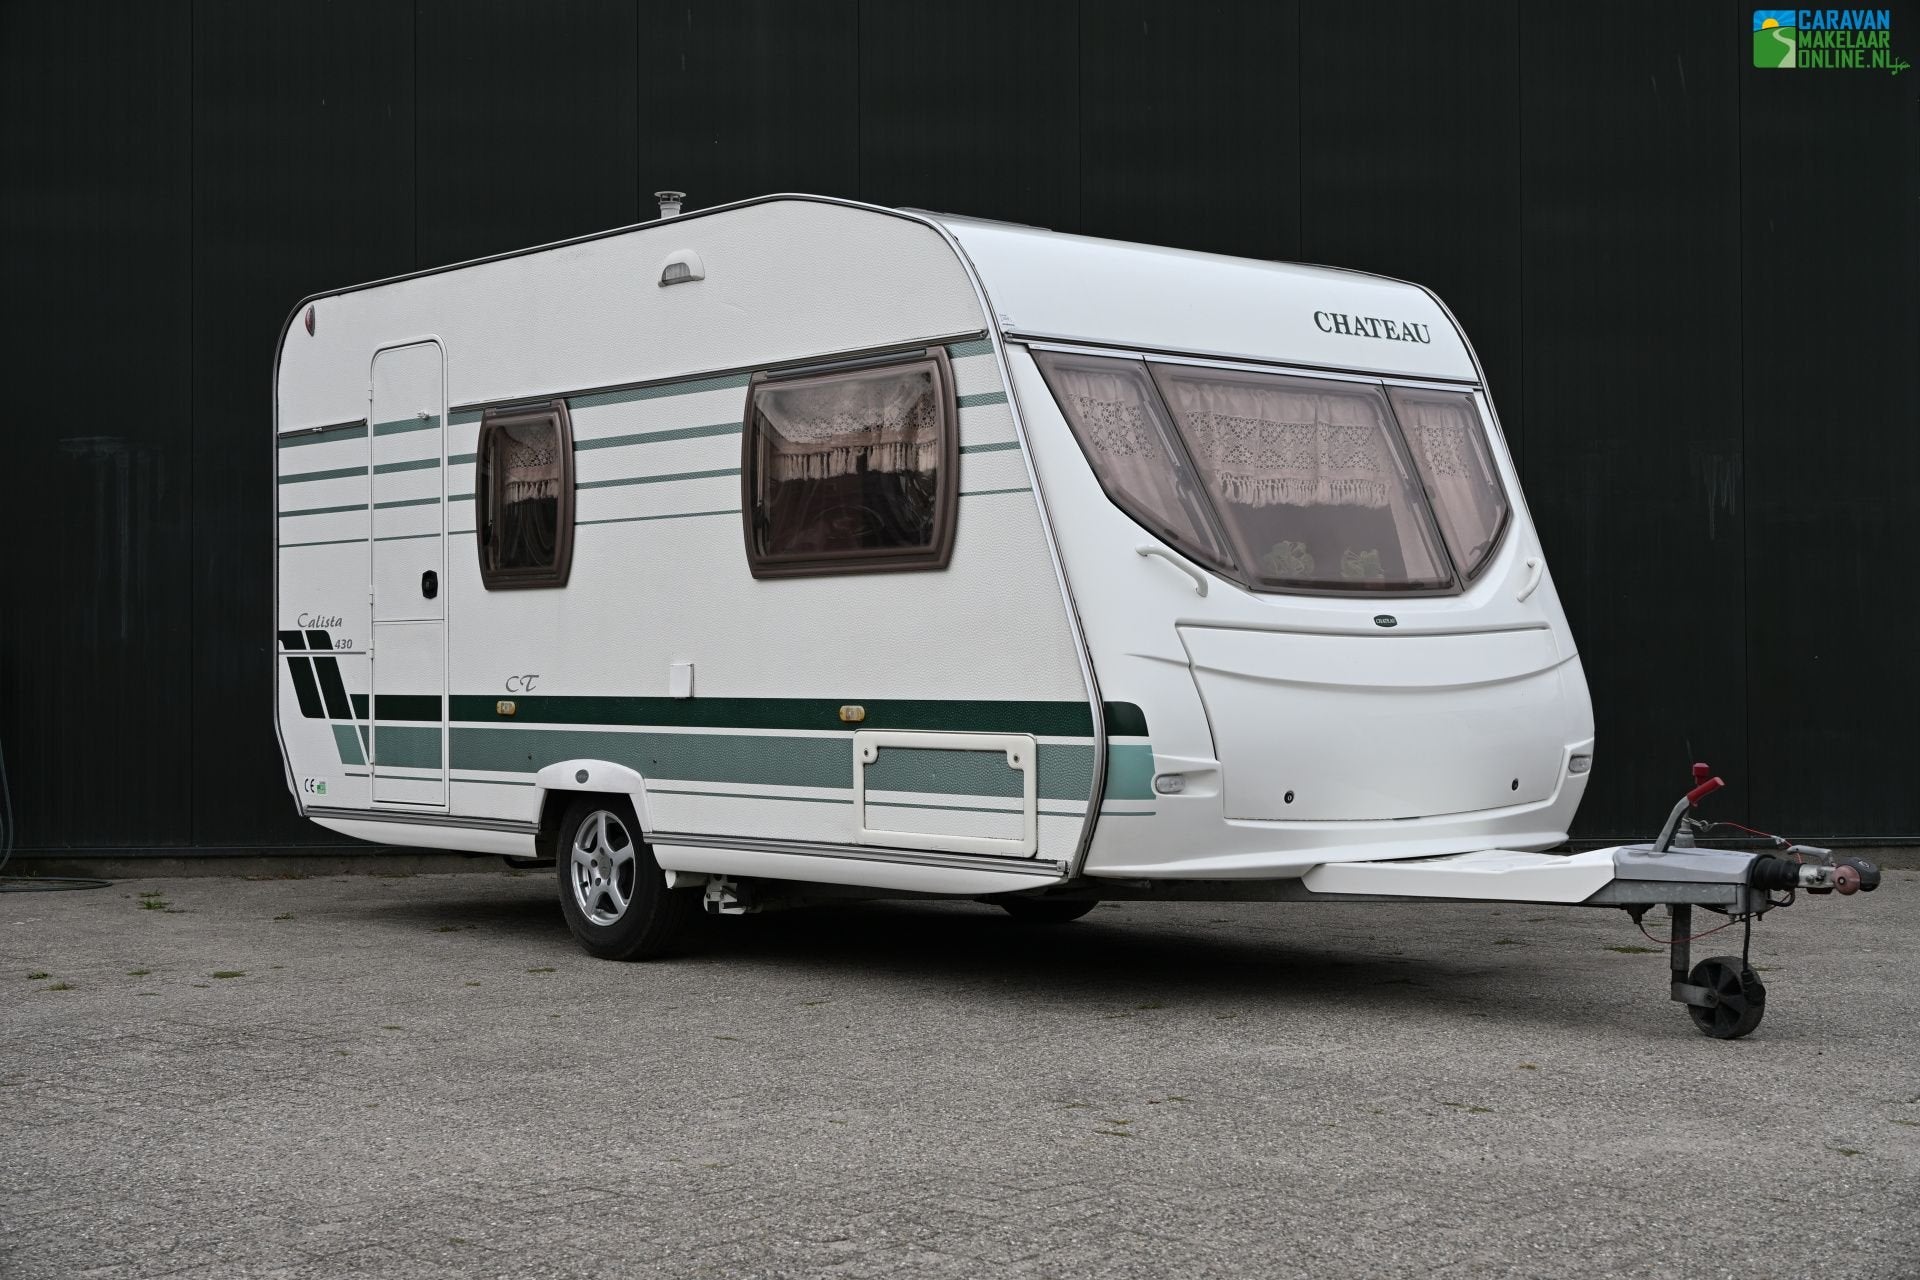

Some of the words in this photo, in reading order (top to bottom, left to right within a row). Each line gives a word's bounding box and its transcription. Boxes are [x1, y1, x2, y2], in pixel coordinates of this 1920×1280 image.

[1313, 310, 1431, 344] CHATEAU
[297, 612, 343, 628] Calista
[334, 639, 353, 649] 430
[505, 674, 540, 693] CT
